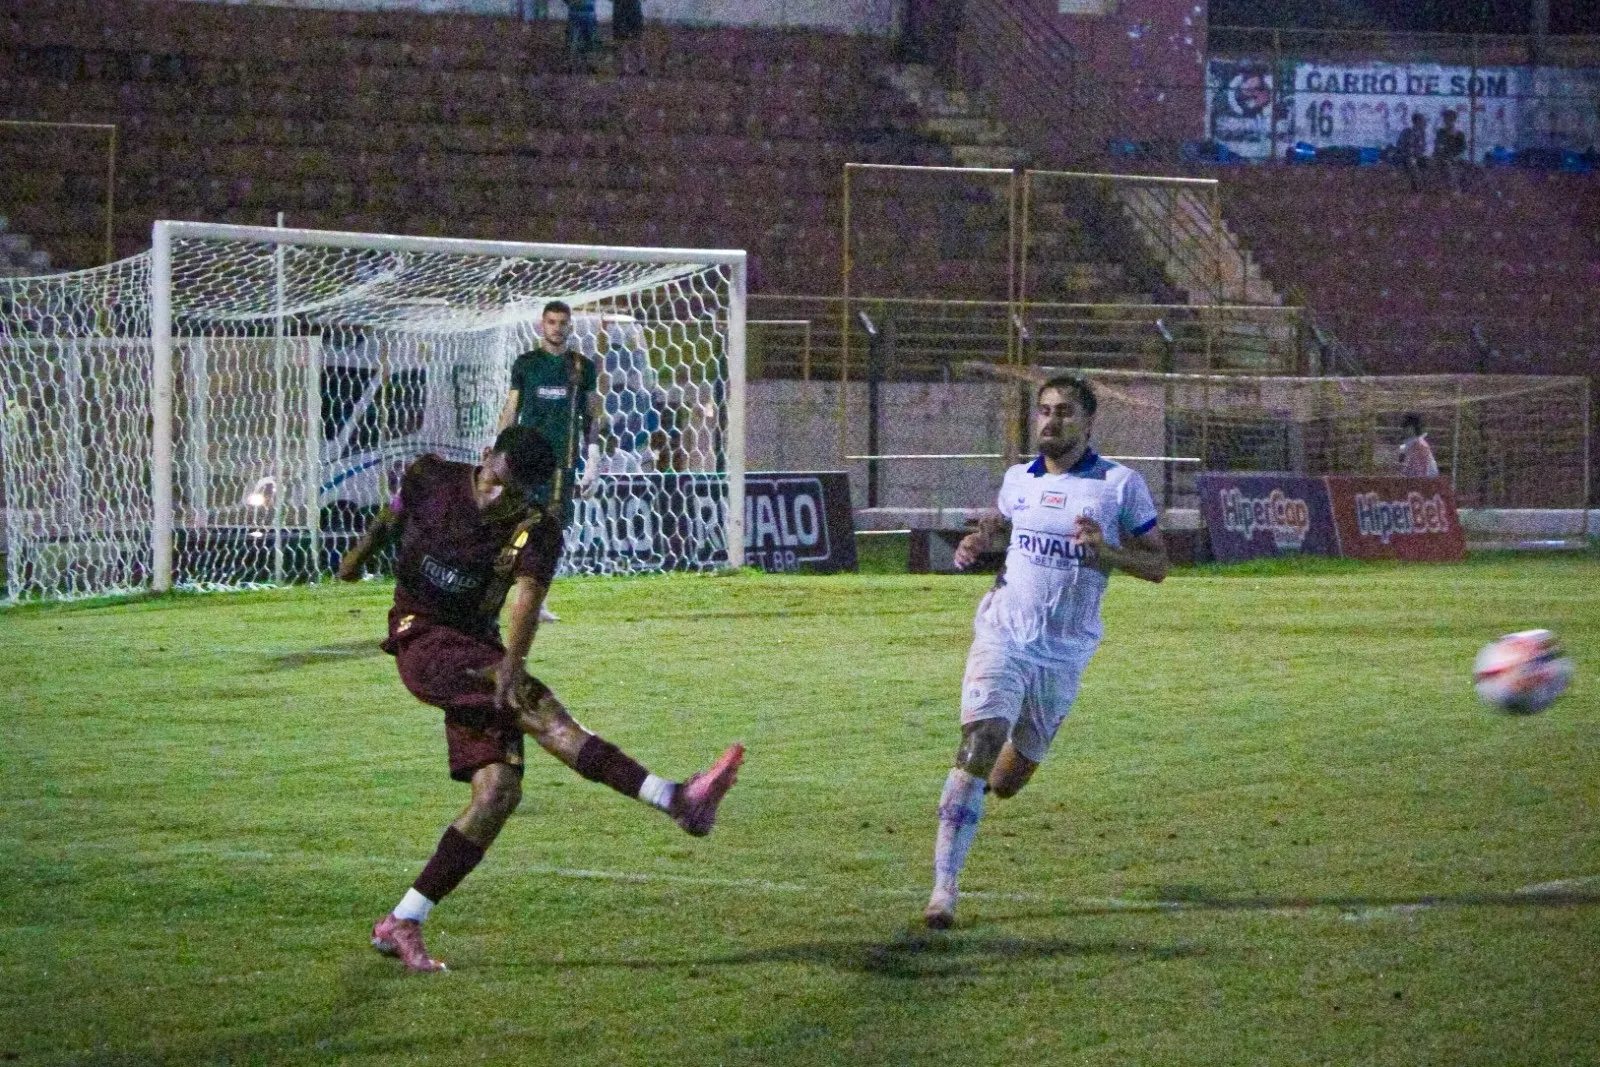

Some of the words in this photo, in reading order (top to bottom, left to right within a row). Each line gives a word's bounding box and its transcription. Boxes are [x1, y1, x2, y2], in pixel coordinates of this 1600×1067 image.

[1305, 70, 1397, 95] CARRO
[1406, 73, 1440, 96] DE
[1450, 73, 1510, 97] SOM
[1306, 99, 1334, 137] 16
[1356, 492, 1449, 543] HiperBet
[1018, 534, 1086, 560] RIVALO
